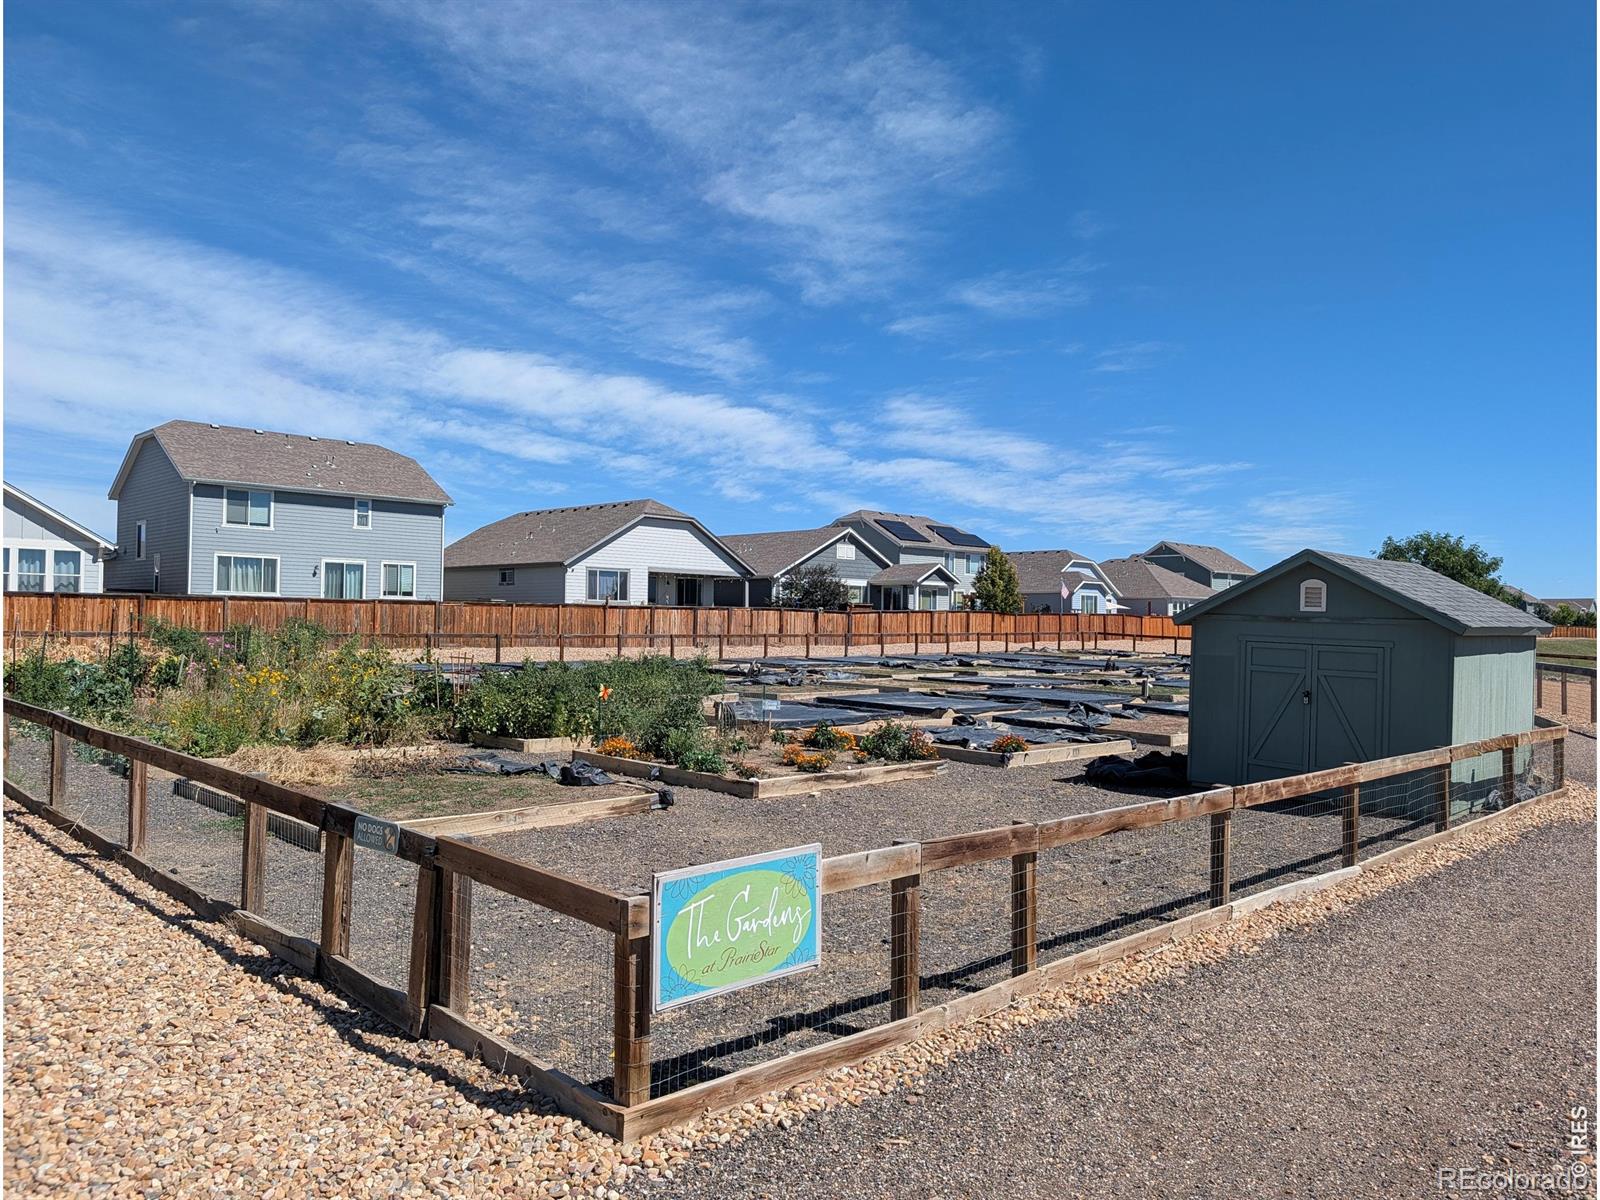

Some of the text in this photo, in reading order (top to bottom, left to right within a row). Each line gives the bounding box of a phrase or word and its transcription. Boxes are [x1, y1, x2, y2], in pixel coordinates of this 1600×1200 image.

[357, 832, 382, 845] ALLOWED
[358, 822, 383, 835] NO DOGS
[678, 884, 812, 959] The Gardens
[701, 940, 781, 975] at PrairieStar
